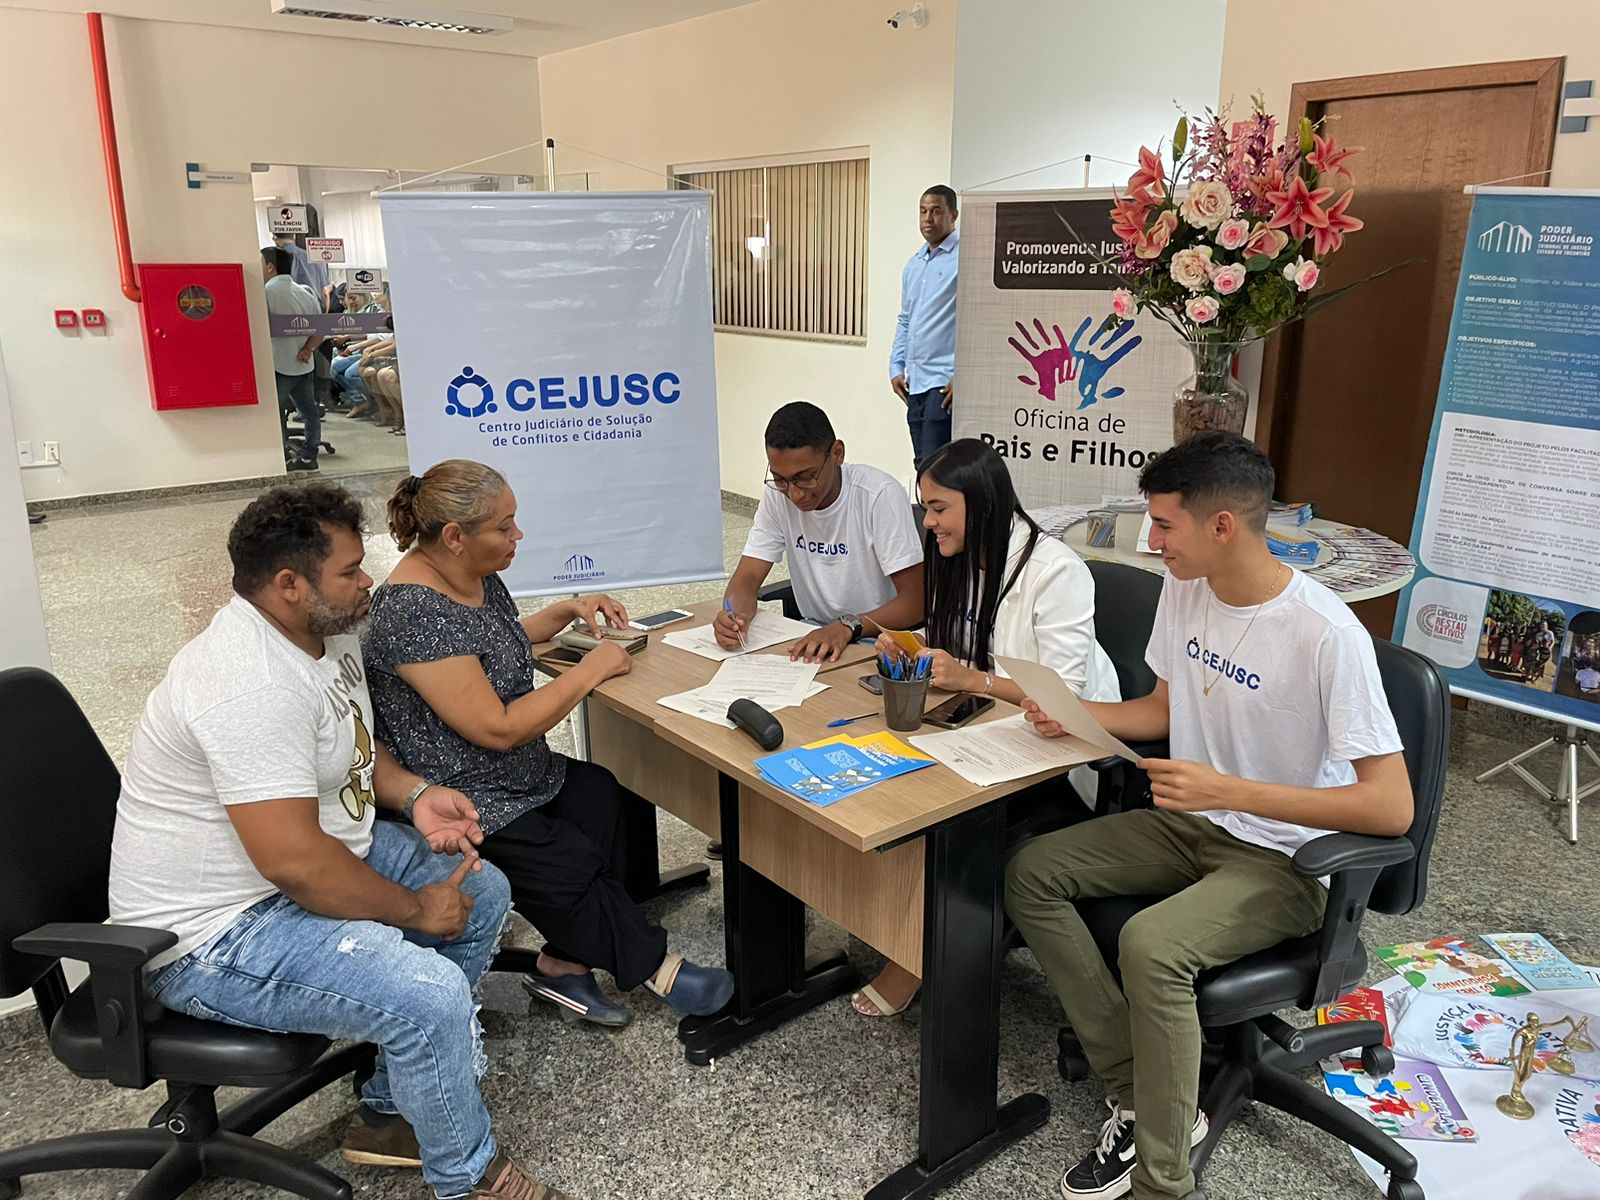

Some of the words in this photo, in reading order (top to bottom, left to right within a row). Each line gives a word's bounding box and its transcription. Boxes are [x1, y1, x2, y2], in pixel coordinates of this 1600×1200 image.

[1541, 225, 1572, 234] PODER
[1539, 234, 1593, 244] JUDICIÁRIO
[1002, 260, 1086, 274] Valorizando
[1089, 264, 1098, 274] a
[1493, 339, 1536, 347] ESPECÍFICOS:
[505, 372, 681, 412] CEJUSC
[478, 421, 521, 433] Centro
[525, 417, 584, 432] Judiciário
[587, 416, 602, 426] de
[606, 413, 653, 427] Solução
[1014, 408, 1089, 432] Oficina
[1098, 413, 1126, 434] de
[492, 436, 508, 446] de
[512, 432, 568, 446] Conflitos
[572, 433, 580, 442] e
[584, 428, 642, 442] Cidadania
[1455, 428, 1496, 436] METODOLOGIA:
[1469, 434, 1513, 444] APRESENTAÇÃO
[980, 433, 1032, 459] Pais
[1042, 442, 1058, 462] e
[1529, 484, 1562, 492] CONVERSA
[1434, 537, 1471, 546] CONSTRUÇÃO
[1438, 608, 1468, 622] CÍRCULOS
[1436, 616, 1467, 632] RESTAU
[1434, 626, 1465, 640] RATIVOS
[1202, 649, 1260, 690] CEJUSC
[1435, 1006, 1470, 1041] JUSTIÇA
[1415, 1073, 1455, 1130] CINDERELA
